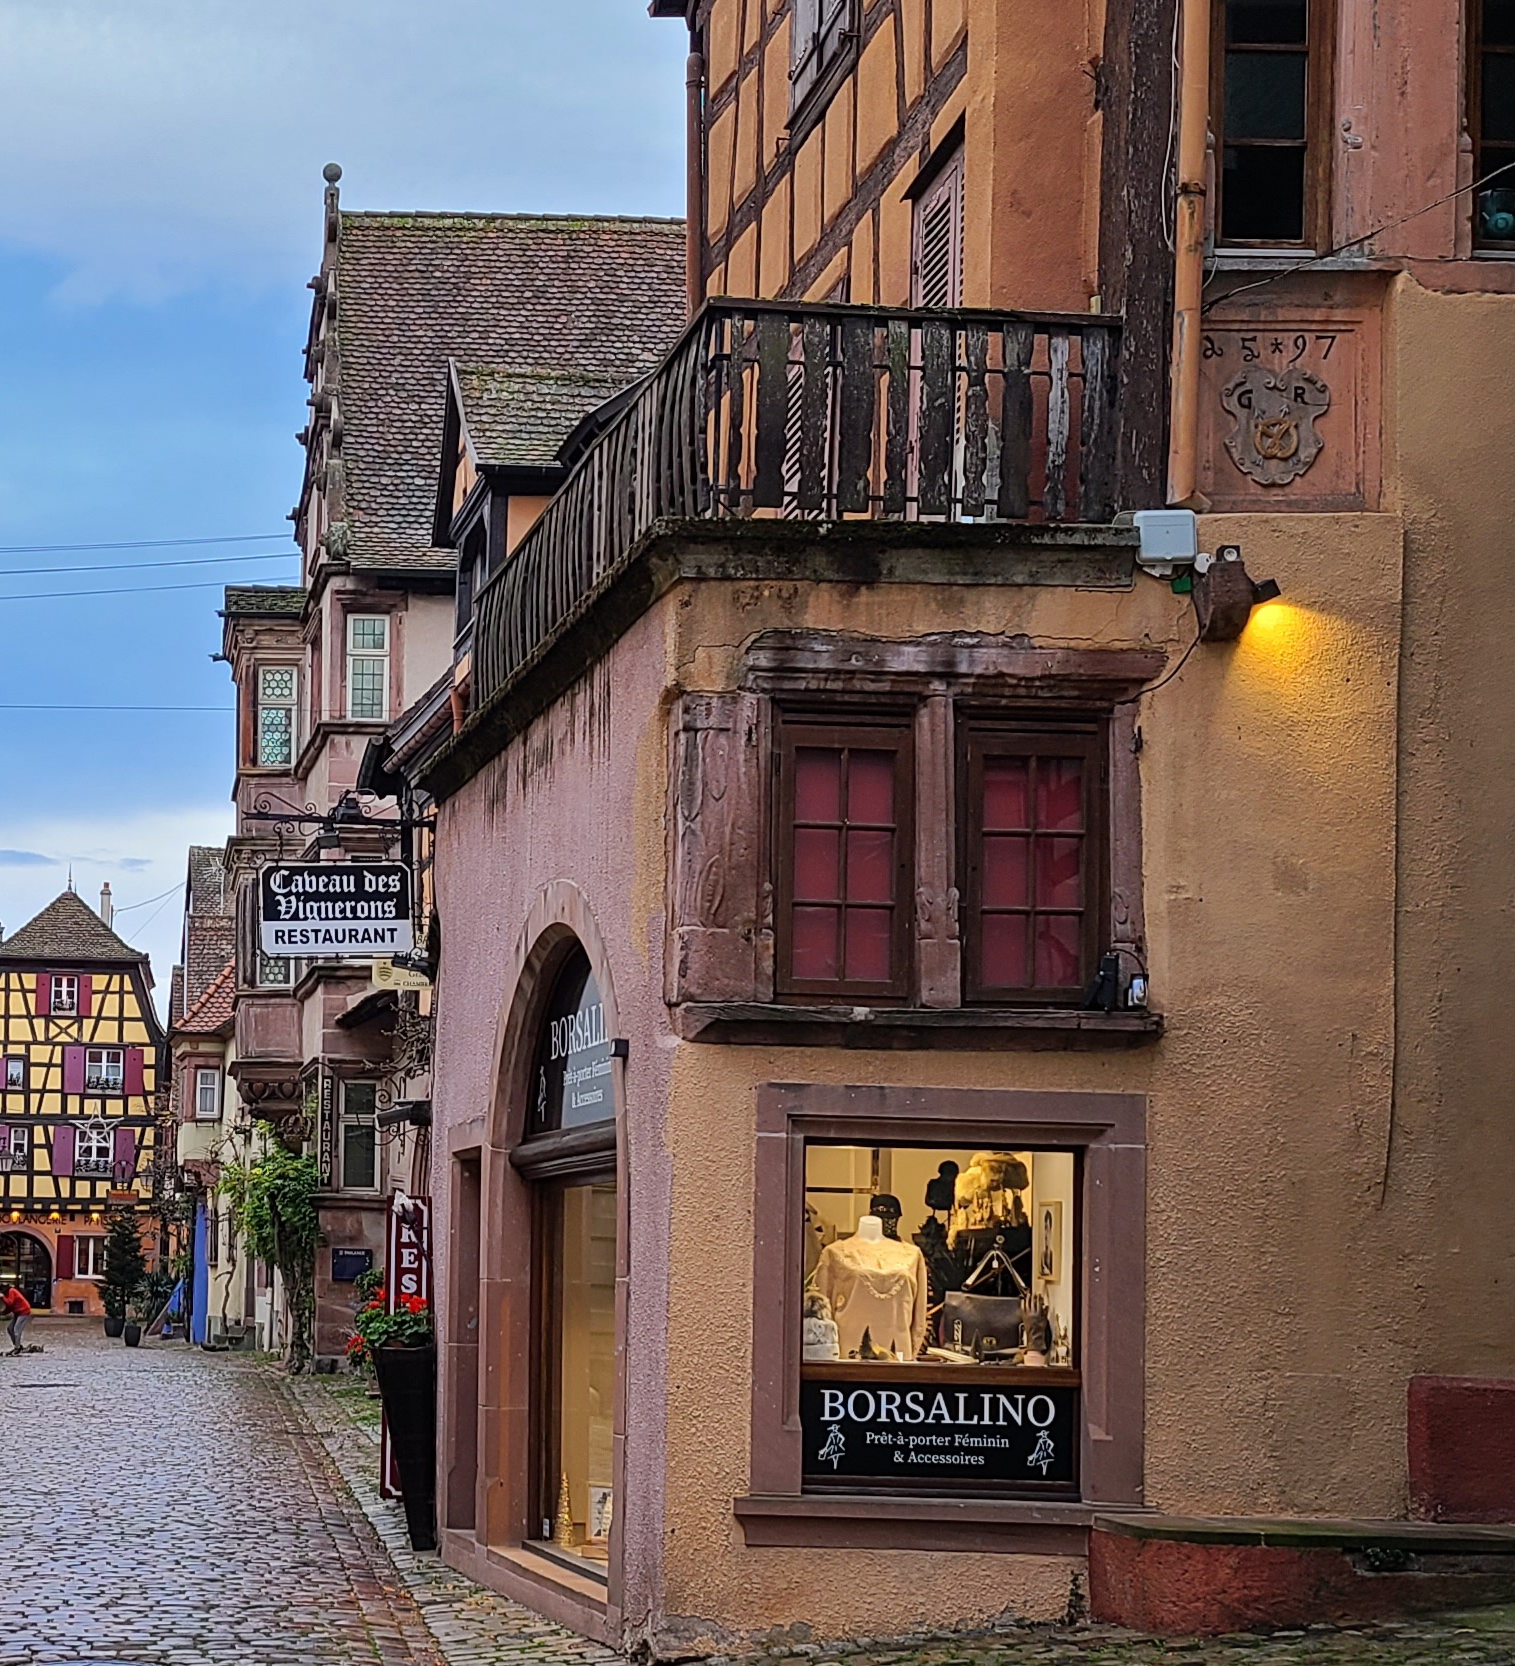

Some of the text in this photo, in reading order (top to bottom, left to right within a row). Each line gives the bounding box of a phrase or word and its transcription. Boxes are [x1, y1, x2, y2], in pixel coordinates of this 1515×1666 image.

[1237, 389, 1254, 409] G
[270, 869, 401, 893] Caveau des
[274, 895, 397, 921] Vignerons
[274, 927, 398, 945] RESTAURANT
[321, 1078, 332, 1184] RESTAURANT
[819, 1389, 1056, 1427] BORSALINO
[865, 1431, 1010, 1448] Prêt-à-porter Féminin
[893, 1450, 985, 1465] & Accessoires
